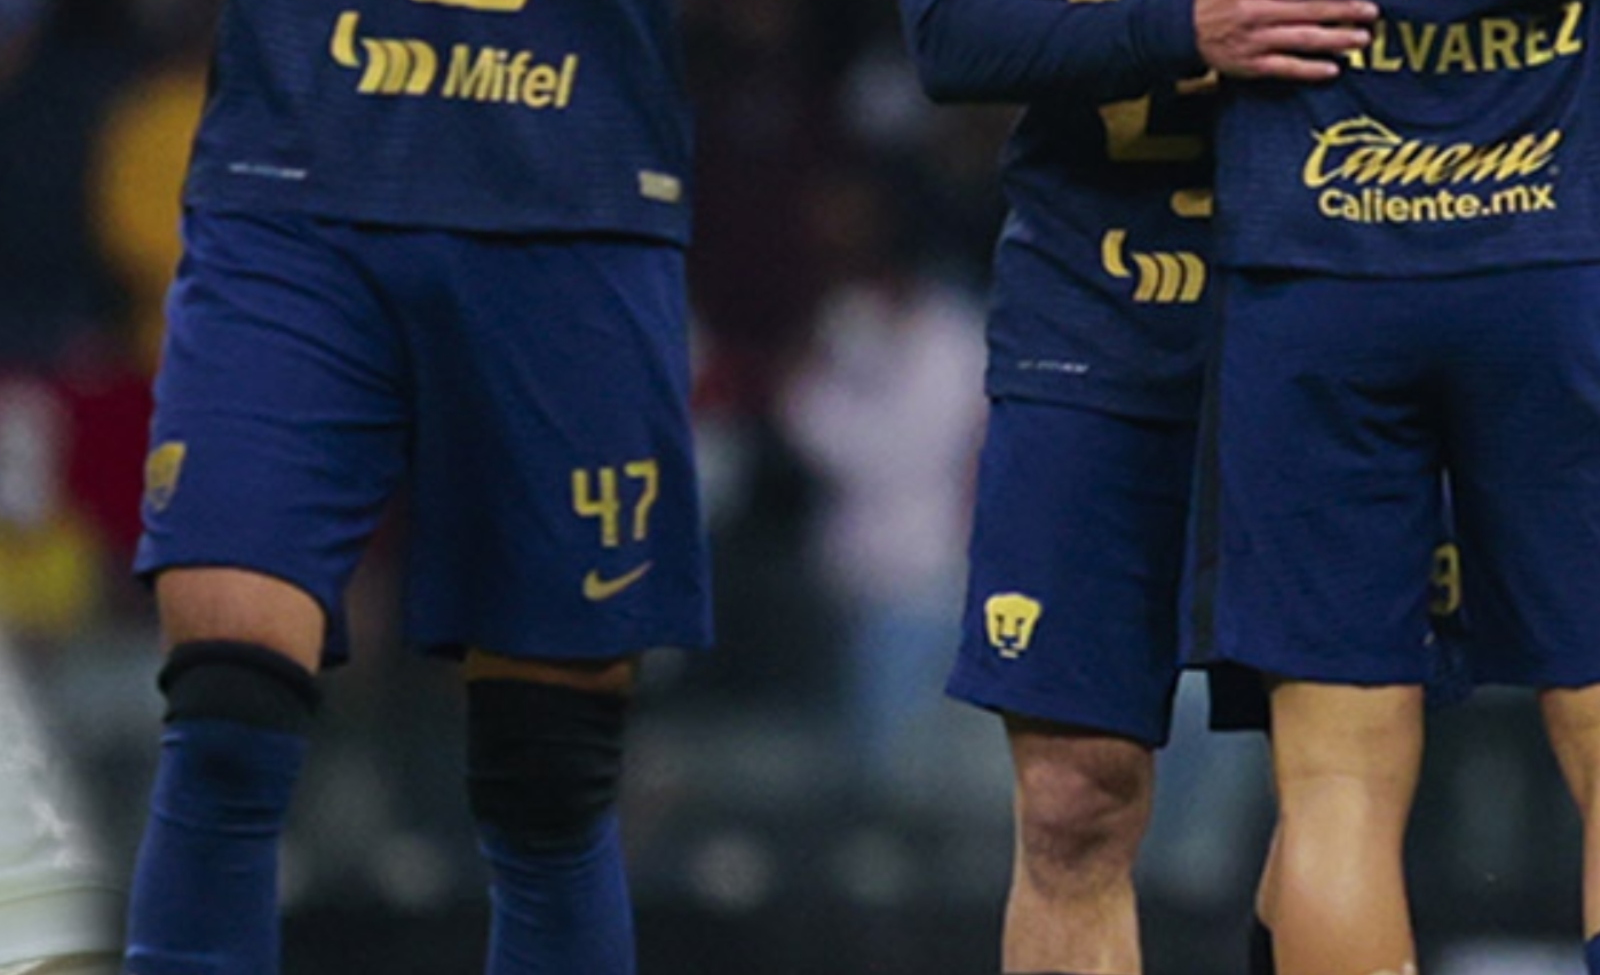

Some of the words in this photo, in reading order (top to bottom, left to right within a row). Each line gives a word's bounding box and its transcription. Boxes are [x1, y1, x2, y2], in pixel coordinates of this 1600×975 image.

[442, 44, 578, 108] Mifel
[1318, 185, 1556, 223] Caliente.mx
[571, 458, 659, 547] 47
